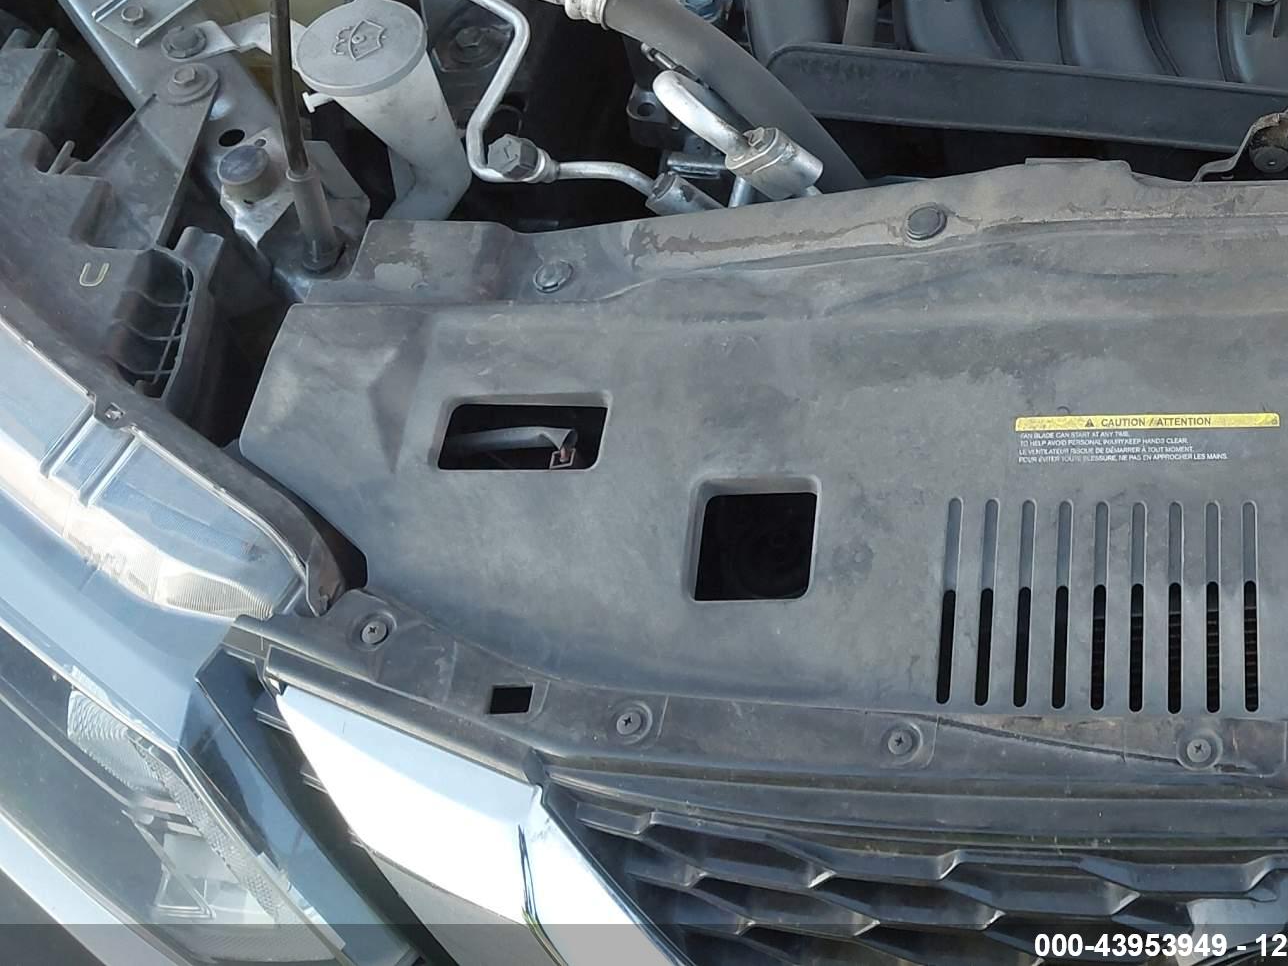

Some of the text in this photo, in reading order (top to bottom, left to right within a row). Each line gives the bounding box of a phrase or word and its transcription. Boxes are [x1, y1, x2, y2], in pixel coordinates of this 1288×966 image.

[79, 262, 110, 287] U
[1101, 417, 1146, 427] CAUTION
[1156, 417, 1211, 426] ATTENTION
